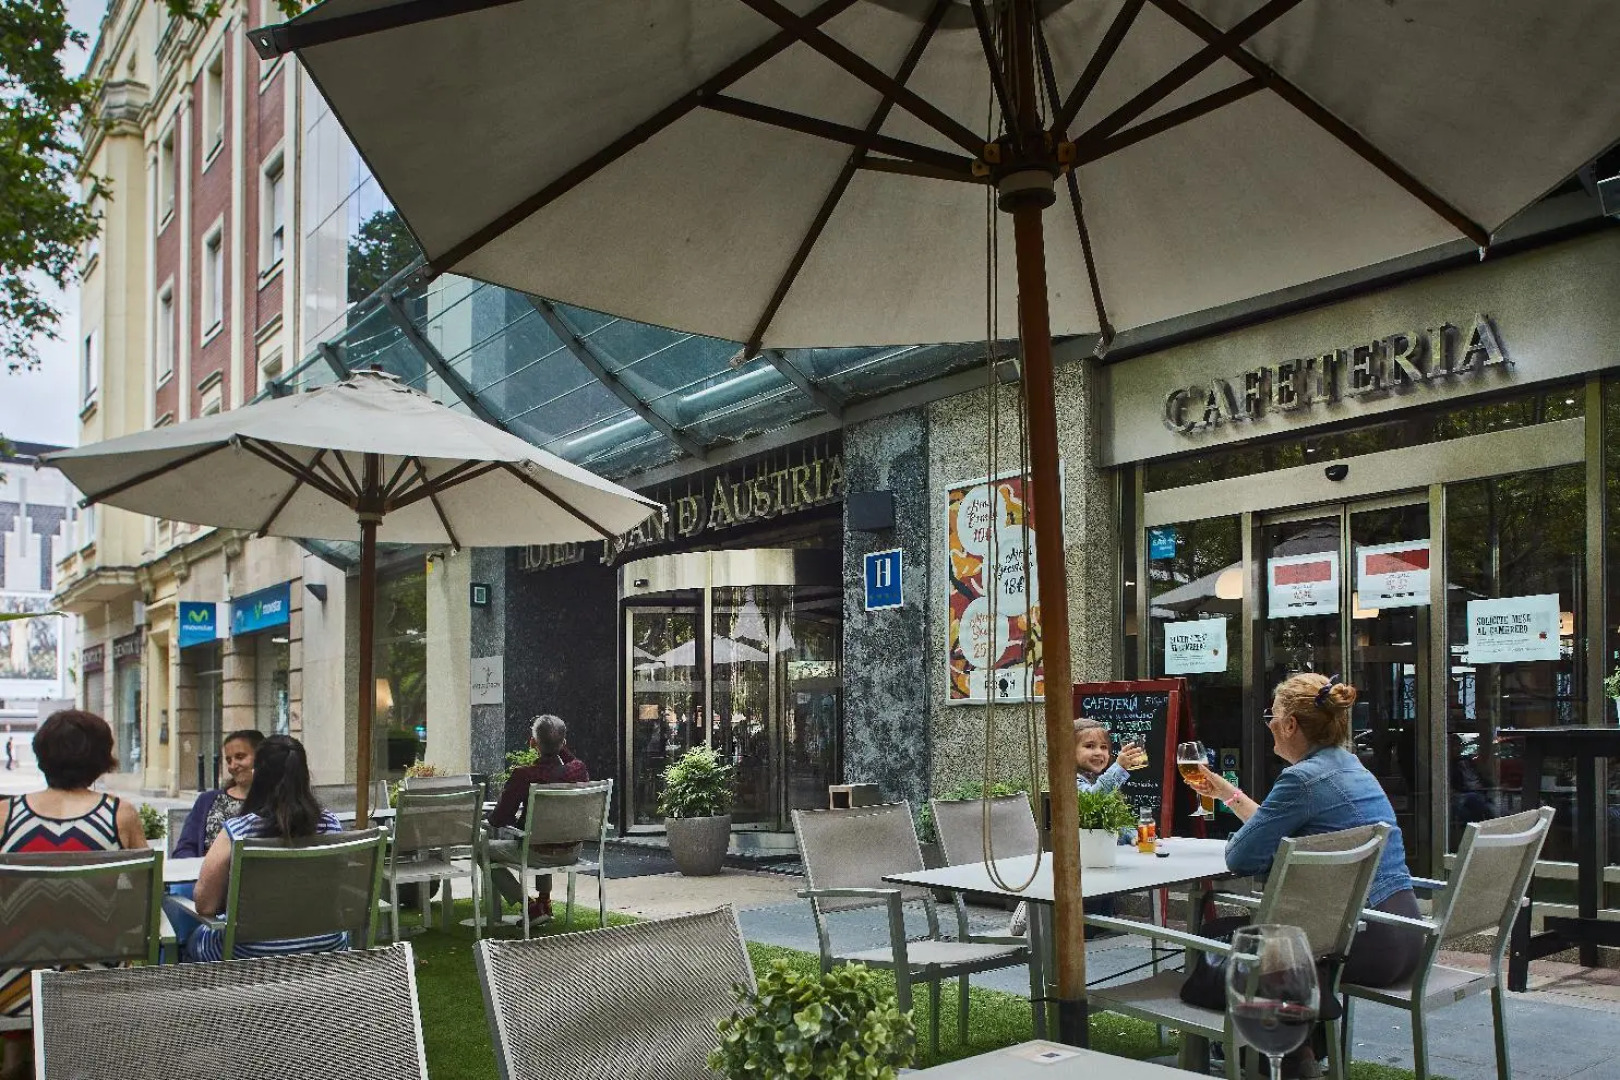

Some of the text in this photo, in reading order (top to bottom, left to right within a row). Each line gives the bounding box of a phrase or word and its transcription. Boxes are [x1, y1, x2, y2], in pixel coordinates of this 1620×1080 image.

[1162, 313, 1515, 435] CAFETERIA
[874, 557, 892, 588] H
[1082, 694, 1138, 711] CAFETERÍA
